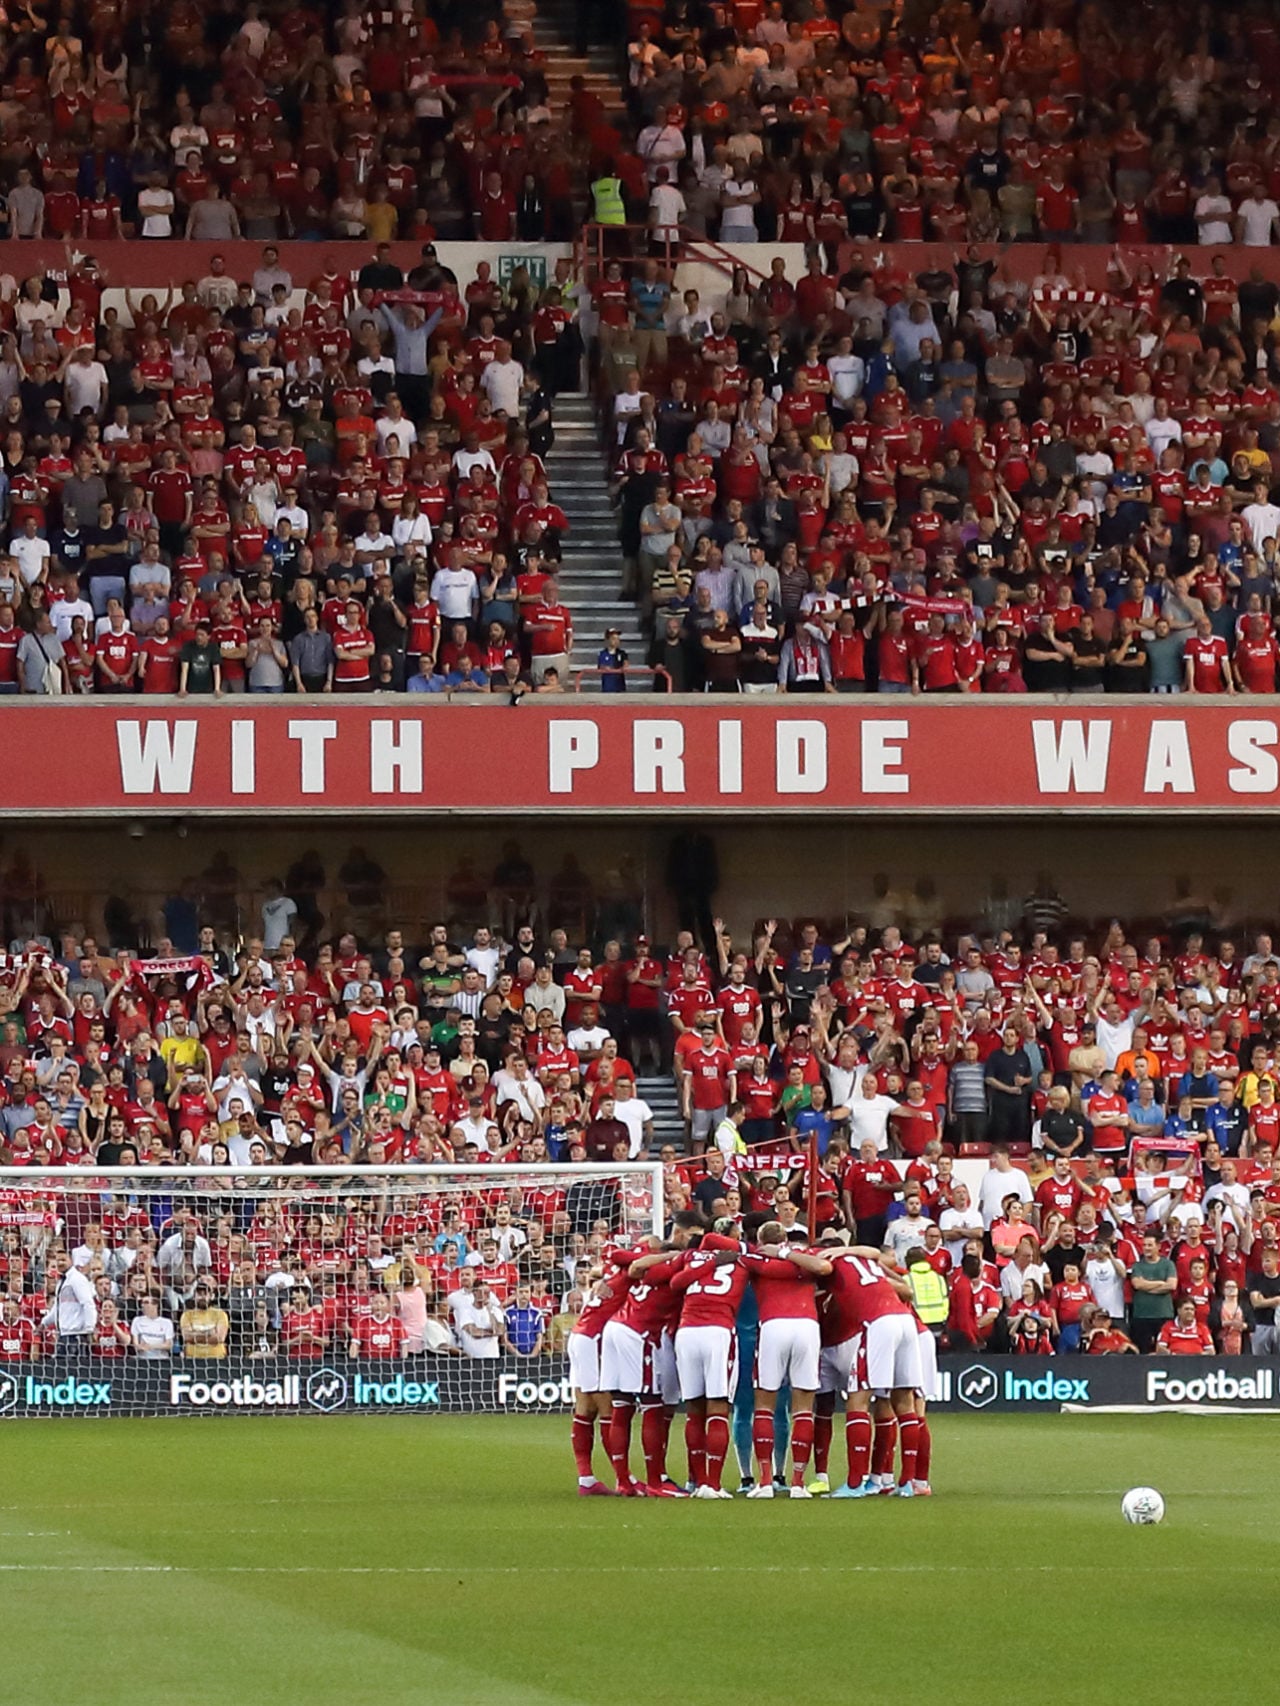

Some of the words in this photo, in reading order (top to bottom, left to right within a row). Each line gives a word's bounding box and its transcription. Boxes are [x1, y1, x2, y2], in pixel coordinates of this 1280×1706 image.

[116, 719, 423, 794] WITH
[549, 719, 909, 794] PRIDE
[1031, 719, 1280, 794] WAS
[735, 1154, 806, 1169] NFFC
[25, 1376, 111, 1405] Index
[171, 1374, 299, 1405] Football
[354, 1374, 440, 1404] Index
[499, 1373, 577, 1404] Foot
[1005, 1369, 1090, 1401] Index
[1147, 1369, 1273, 1401] Football
